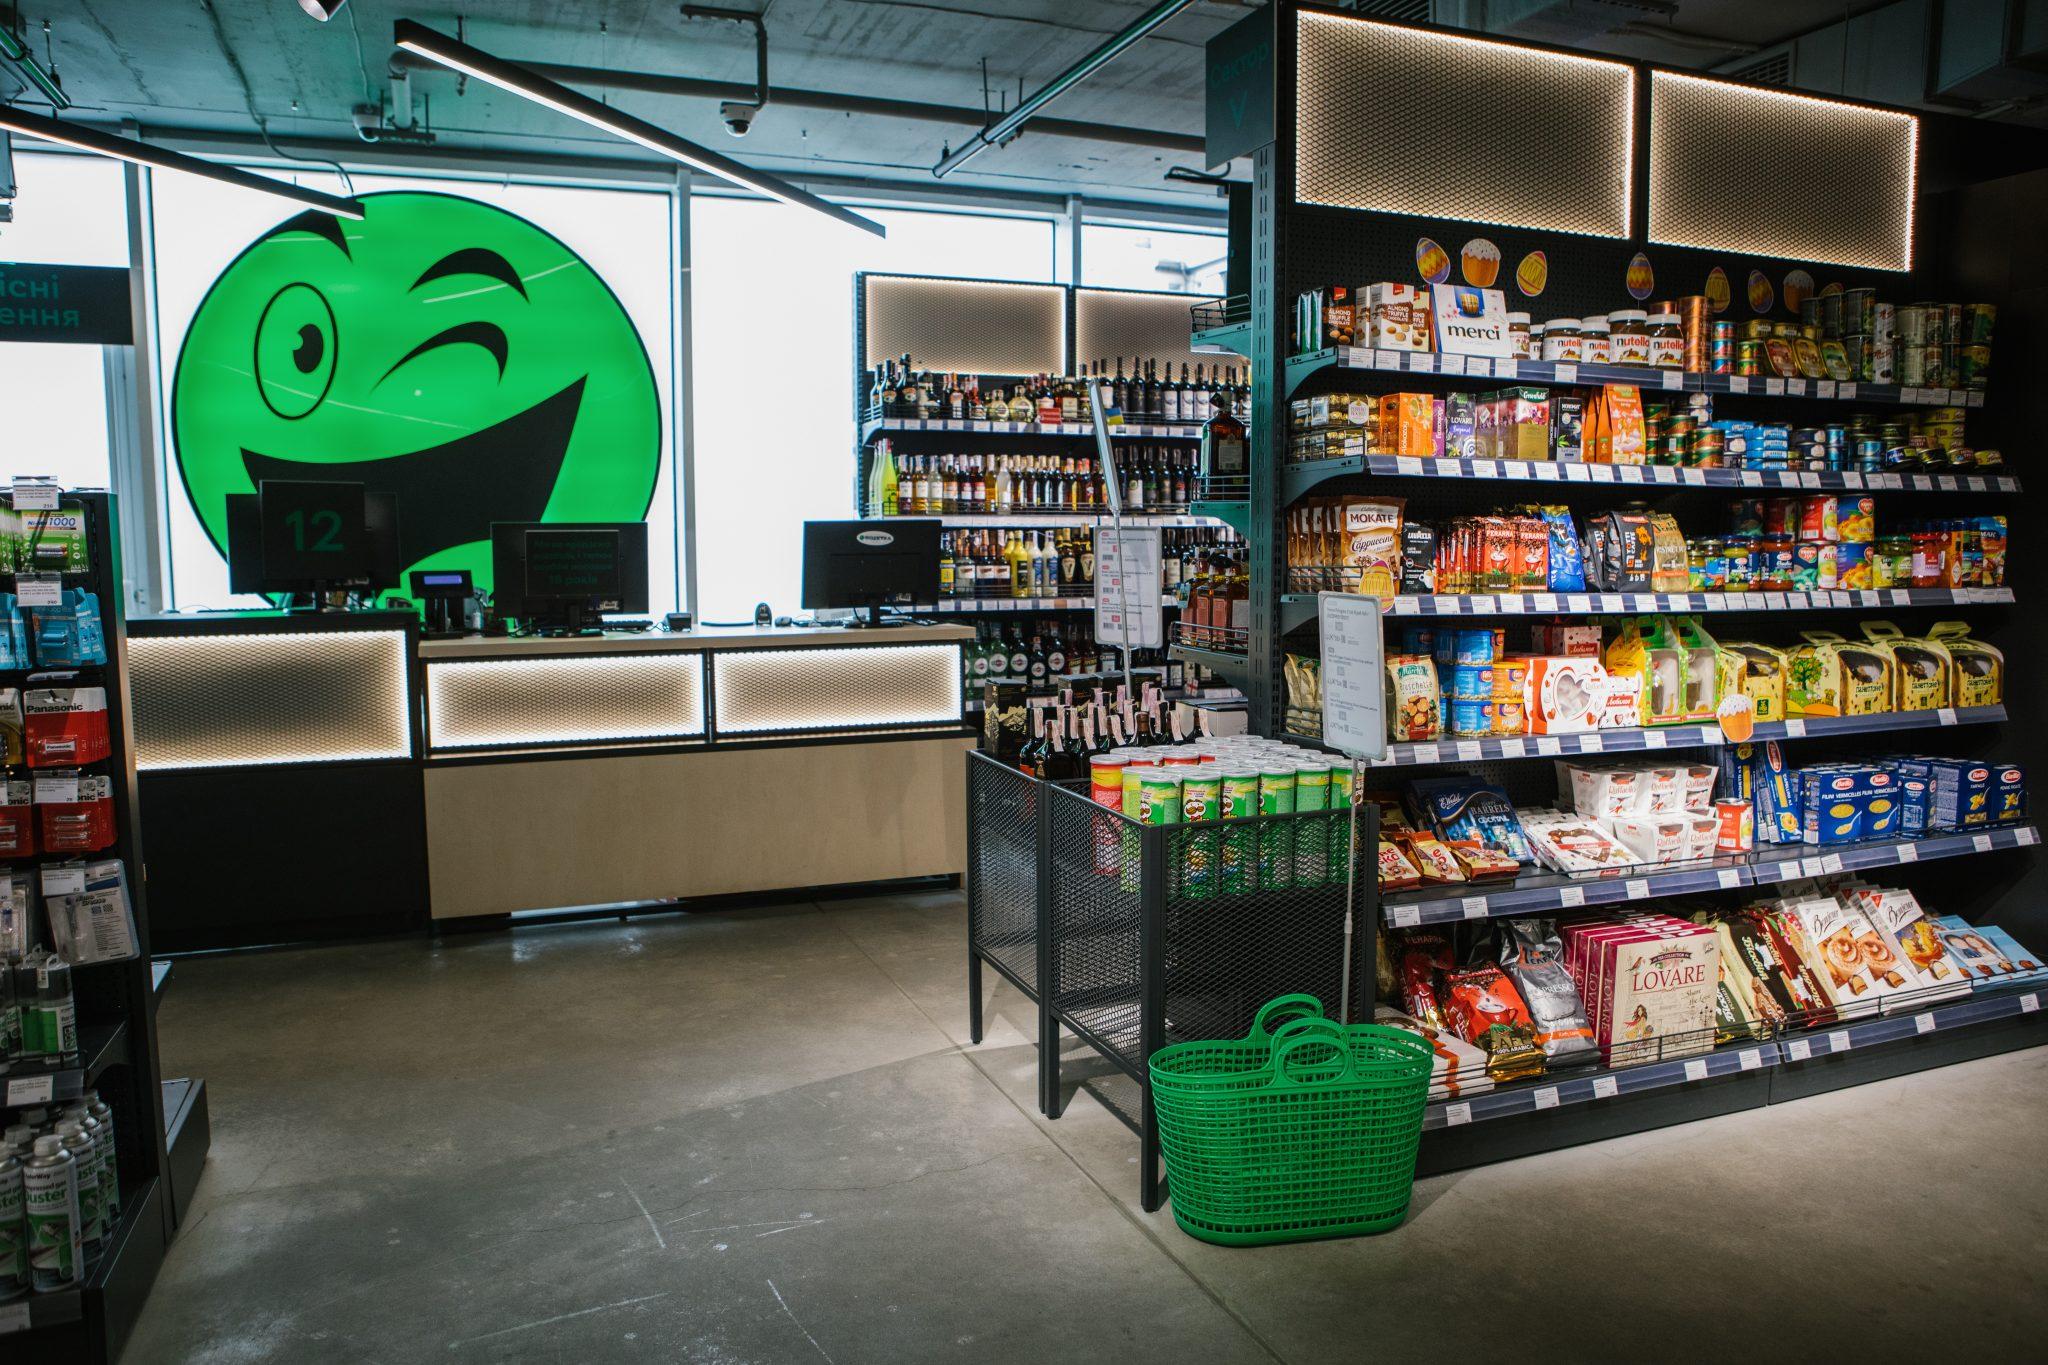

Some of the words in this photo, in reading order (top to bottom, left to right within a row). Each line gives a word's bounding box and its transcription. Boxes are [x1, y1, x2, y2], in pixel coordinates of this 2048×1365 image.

[1387, 305, 1409, 313] ALMOND
[1447, 325, 1500, 340] merci
[1451, 417, 1473, 425] LOVARE
[49, 517, 76, 526] 1000
[1350, 514, 1394, 523] MOKATE
[285, 509, 345, 552] 12
[26, 702, 84, 713] Panasonic
[1471, 804, 1510, 815] BARRELS
[1633, 964, 1705, 991] LOVARE
[1587, 972, 1600, 1025] LOVARE
[1601, 976, 1614, 1030] LOVARE
[1511, 1044, 1534, 1053] ARABICA
